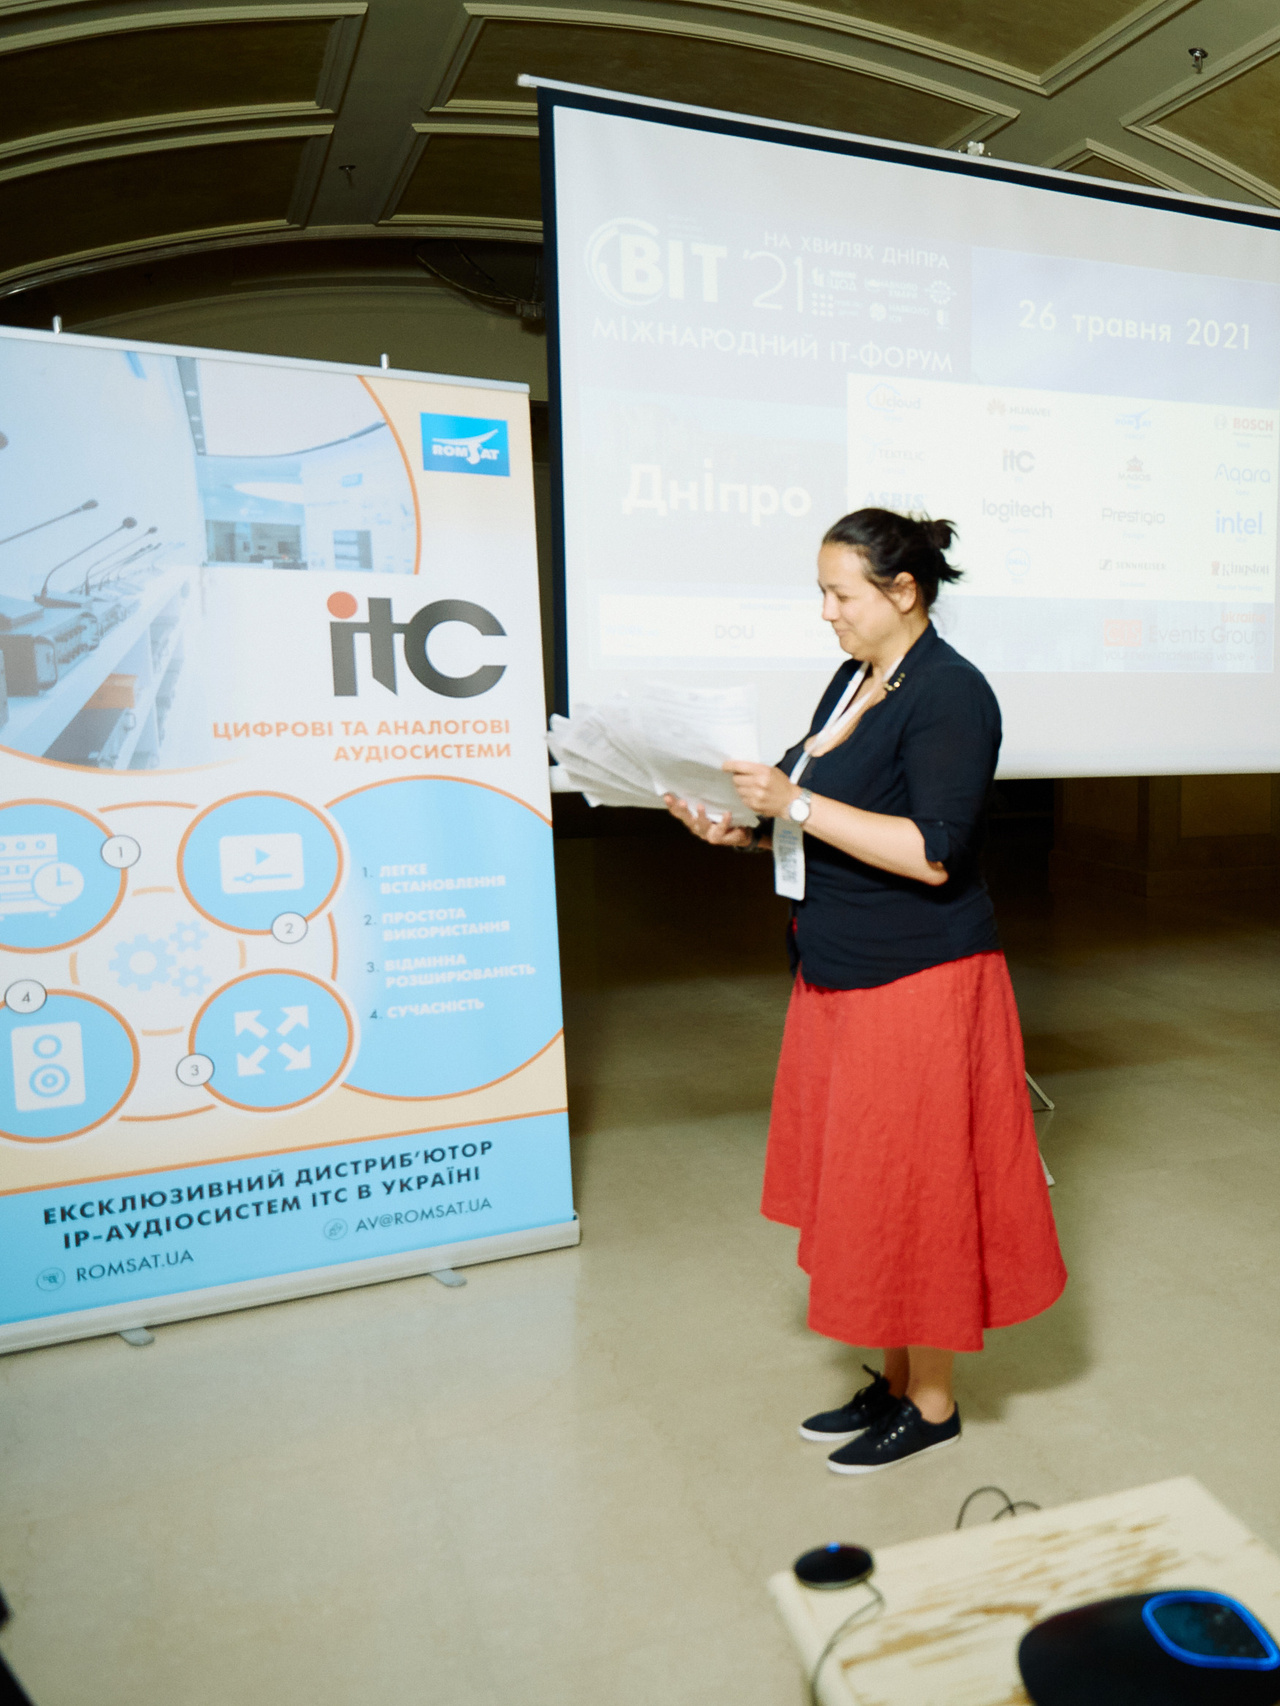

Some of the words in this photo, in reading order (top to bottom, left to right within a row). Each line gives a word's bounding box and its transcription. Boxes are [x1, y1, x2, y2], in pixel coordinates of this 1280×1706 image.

[764, 231, 792, 250] НА
[801, 236, 874, 260] ХВИЛЯХ
[882, 245, 951, 270] ДНІПРА
[1018, 299, 1057, 331] 26
[1071, 313, 1172, 343] травня
[1186, 317, 1250, 350] 2021
[591, 315, 818, 360] МІЖНАРОДНИЙ
[1232, 417, 1274, 431] BOSCH
[431, 442, 500, 465] ROMSAT
[1214, 462, 1272, 485] Aqara
[621, 458, 812, 527] Дніпро
[981, 498, 1053, 524] logitech
[713, 624, 756, 640] DOU
[1148, 624, 1206, 644] Events
[1210, 625, 1267, 646] Group
[213, 722, 334, 740] ЦИФРОВІ
[341, 721, 369, 738] ТА
[377, 719, 511, 738] АНАЛОГОВІ
[334, 743, 512, 763] АУДІОСИСТЕМИ
[379, 863, 428, 877] ЛЕГКЕ
[380, 875, 507, 894] ВСТАНОВЛЕННЯ
[382, 908, 467, 925] ПРОСТОТА
[285, 923, 294, 935] 2
[383, 920, 511, 942] ВИКОРИСТАННЯ
[384, 954, 467, 972] ВІДМІННА
[385, 963, 537, 989] РОЗШИРЮВАНІСТЬ
[22, 992, 31, 1004] 4
[387, 998, 485, 1019] СУЧАСНІСТЬ
[190, 1065, 199, 1077] 3
[383, 1165, 482, 1198] УКРАЇНІ
[43, 1168, 286, 1226] ЕКСКЛЮЗИВНИЙ
[355, 1197, 493, 1234] AV@ROMSAT.UA
[76, 1249, 195, 1282] ROMSAT.UA
